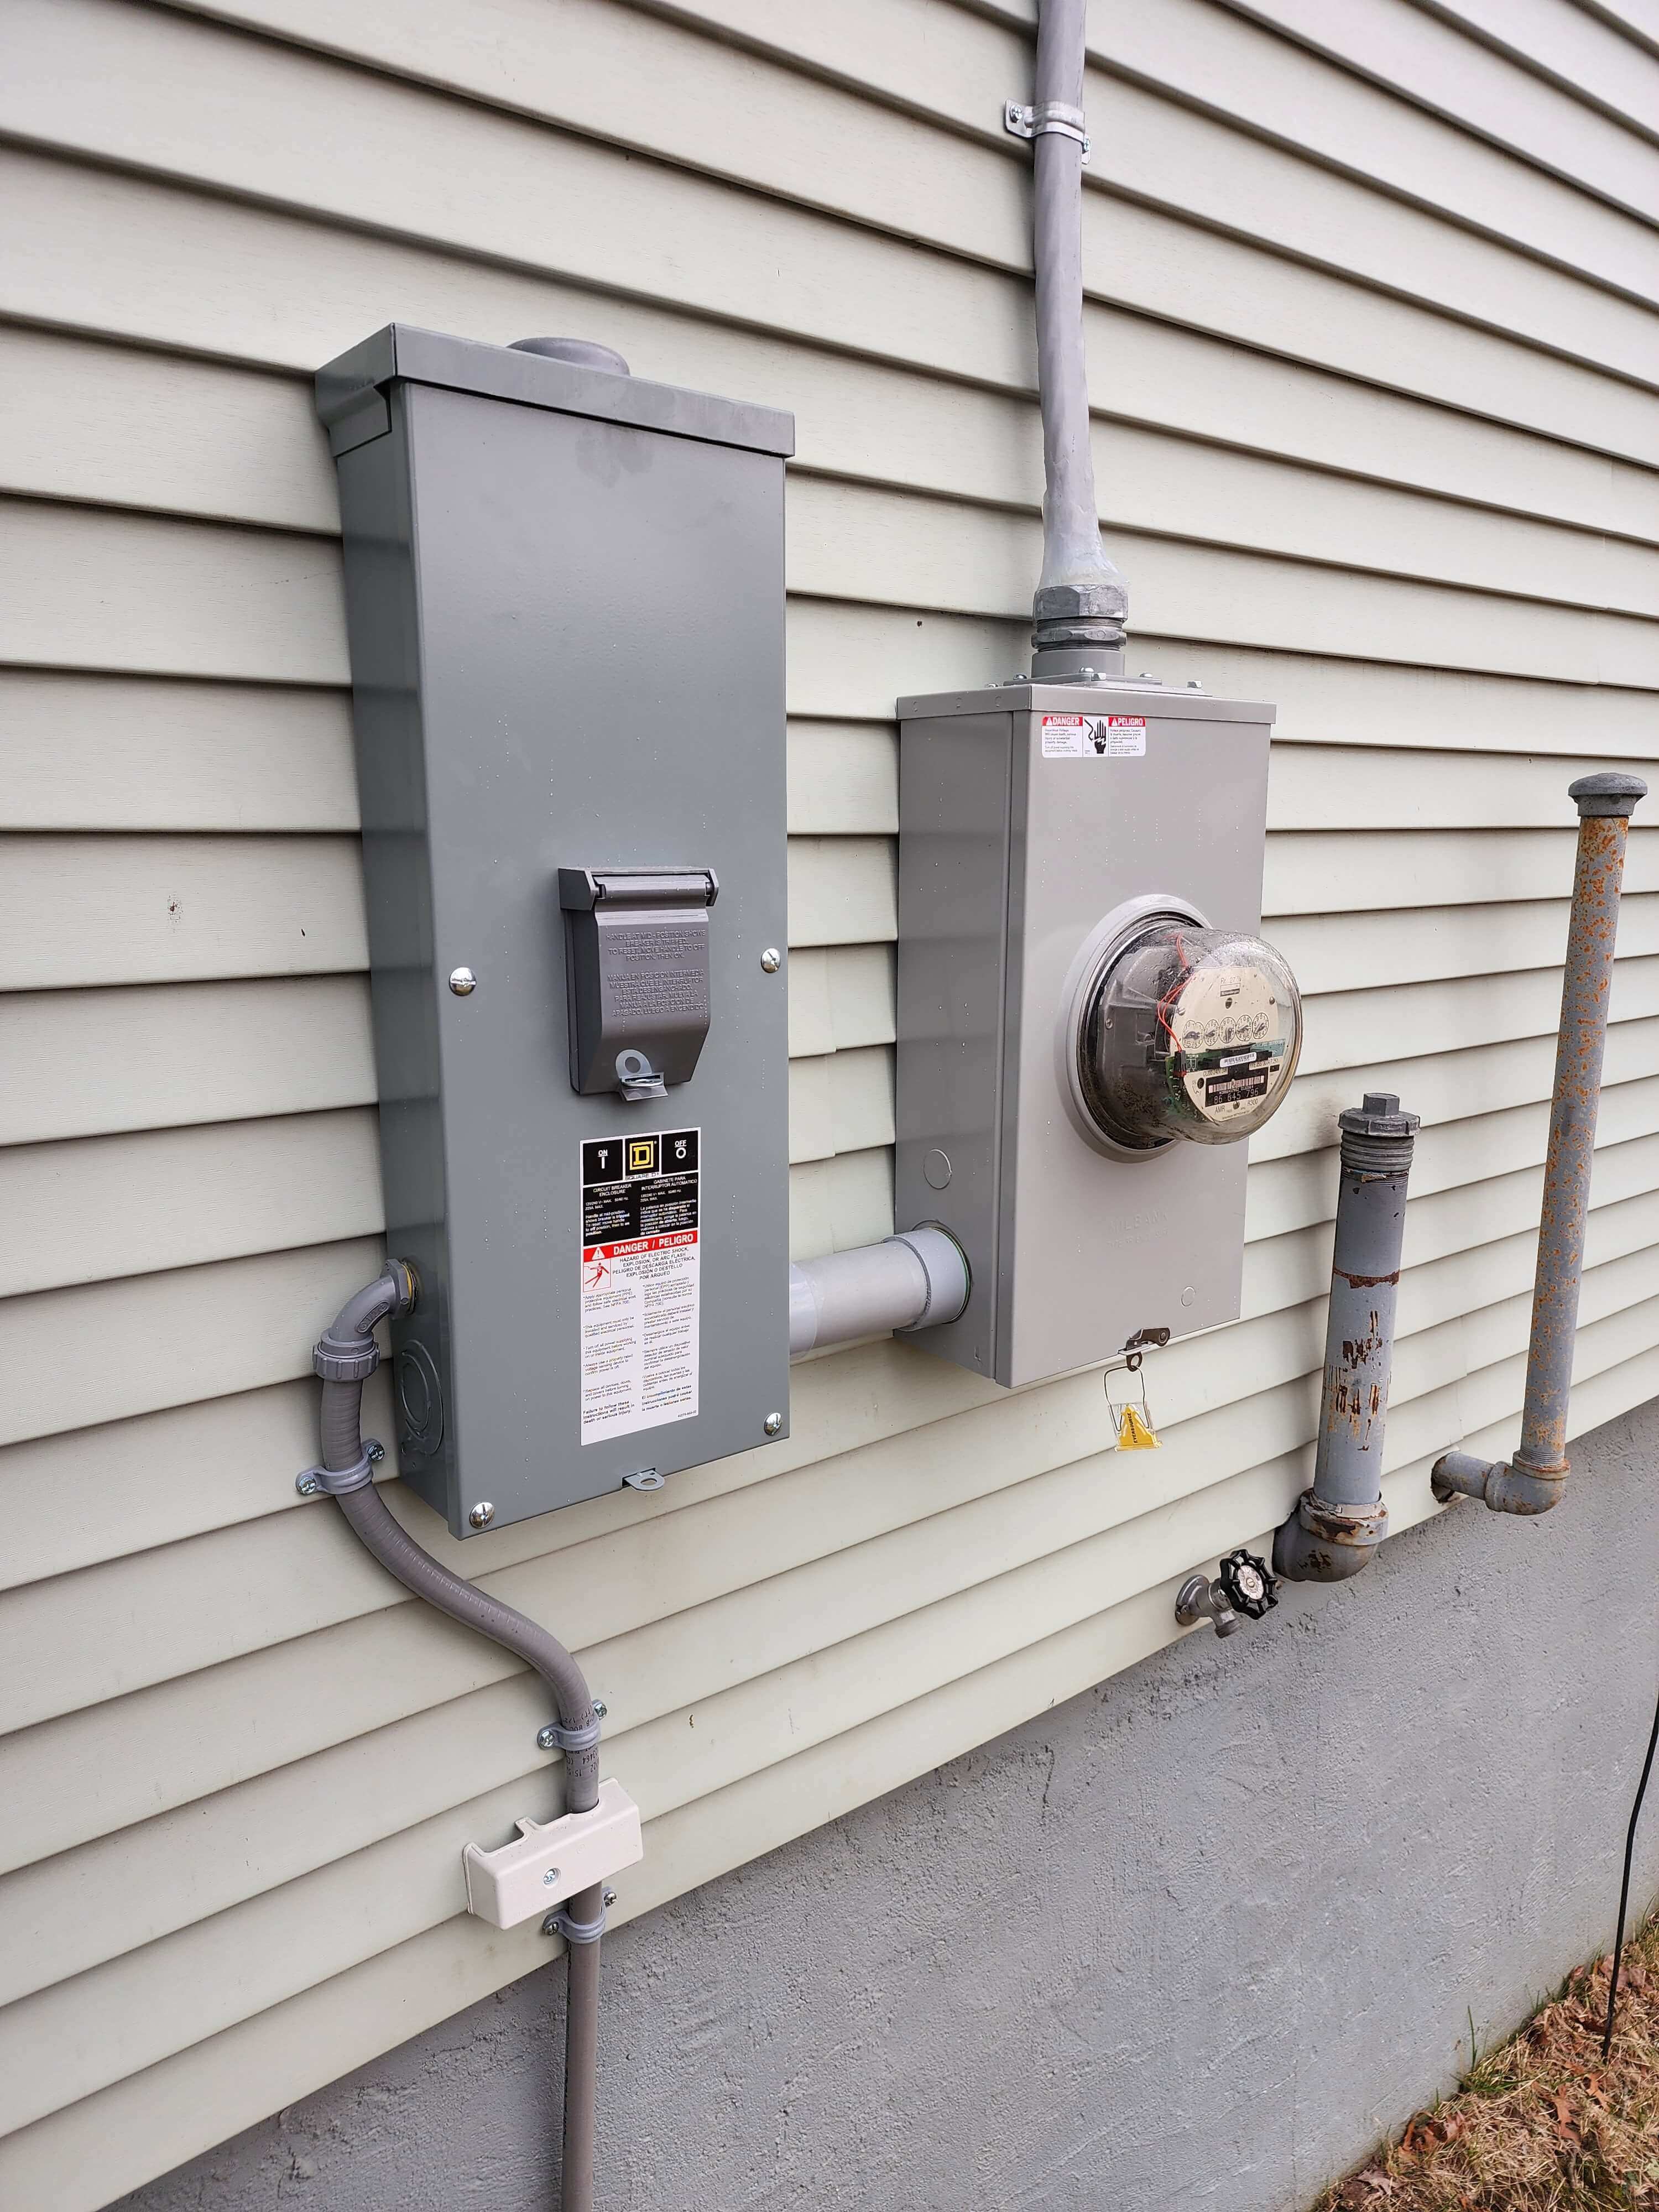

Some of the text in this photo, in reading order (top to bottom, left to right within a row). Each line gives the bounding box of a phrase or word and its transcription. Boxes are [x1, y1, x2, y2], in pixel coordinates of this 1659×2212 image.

[1053, 717, 1079, 726] DANGER
[1118, 717, 1143, 726] PELIGRO
[606, 932, 631, 941] HANDLE
[632, 931, 639, 940] AT
[684, 928, 706, 937] SHOWS
[660, 944, 683, 952] HANDLE
[1214, 1095, 1223, 1104] 86
[1228, 1091, 1241, 1102] 645
[1246, 1087, 1259, 1097] 796
[1215, 1105, 1225, 1114] AMR
[625, 1172, 650, 1181] SQUARE
[641, 1182, 670, 1191] INTERRUPTOR
[599, 1188, 625, 1197] ENCLOSURE
[613, 1233, 693, 1255] DANGER / PELIGRO
[619, 1254, 639, 1263] HAZARD
[648, 1249, 670, 1258] ELECTRIC
[612, 1266, 633, 1275] PELIGRO
[642, 1260, 667, 1269] DESCARGA
[659, 1262, 682, 1271] DESTELLO
[650, 1270, 670, 1279] ARQUEO
[1127, 1412, 1138, 1443] EVERSOURCE
